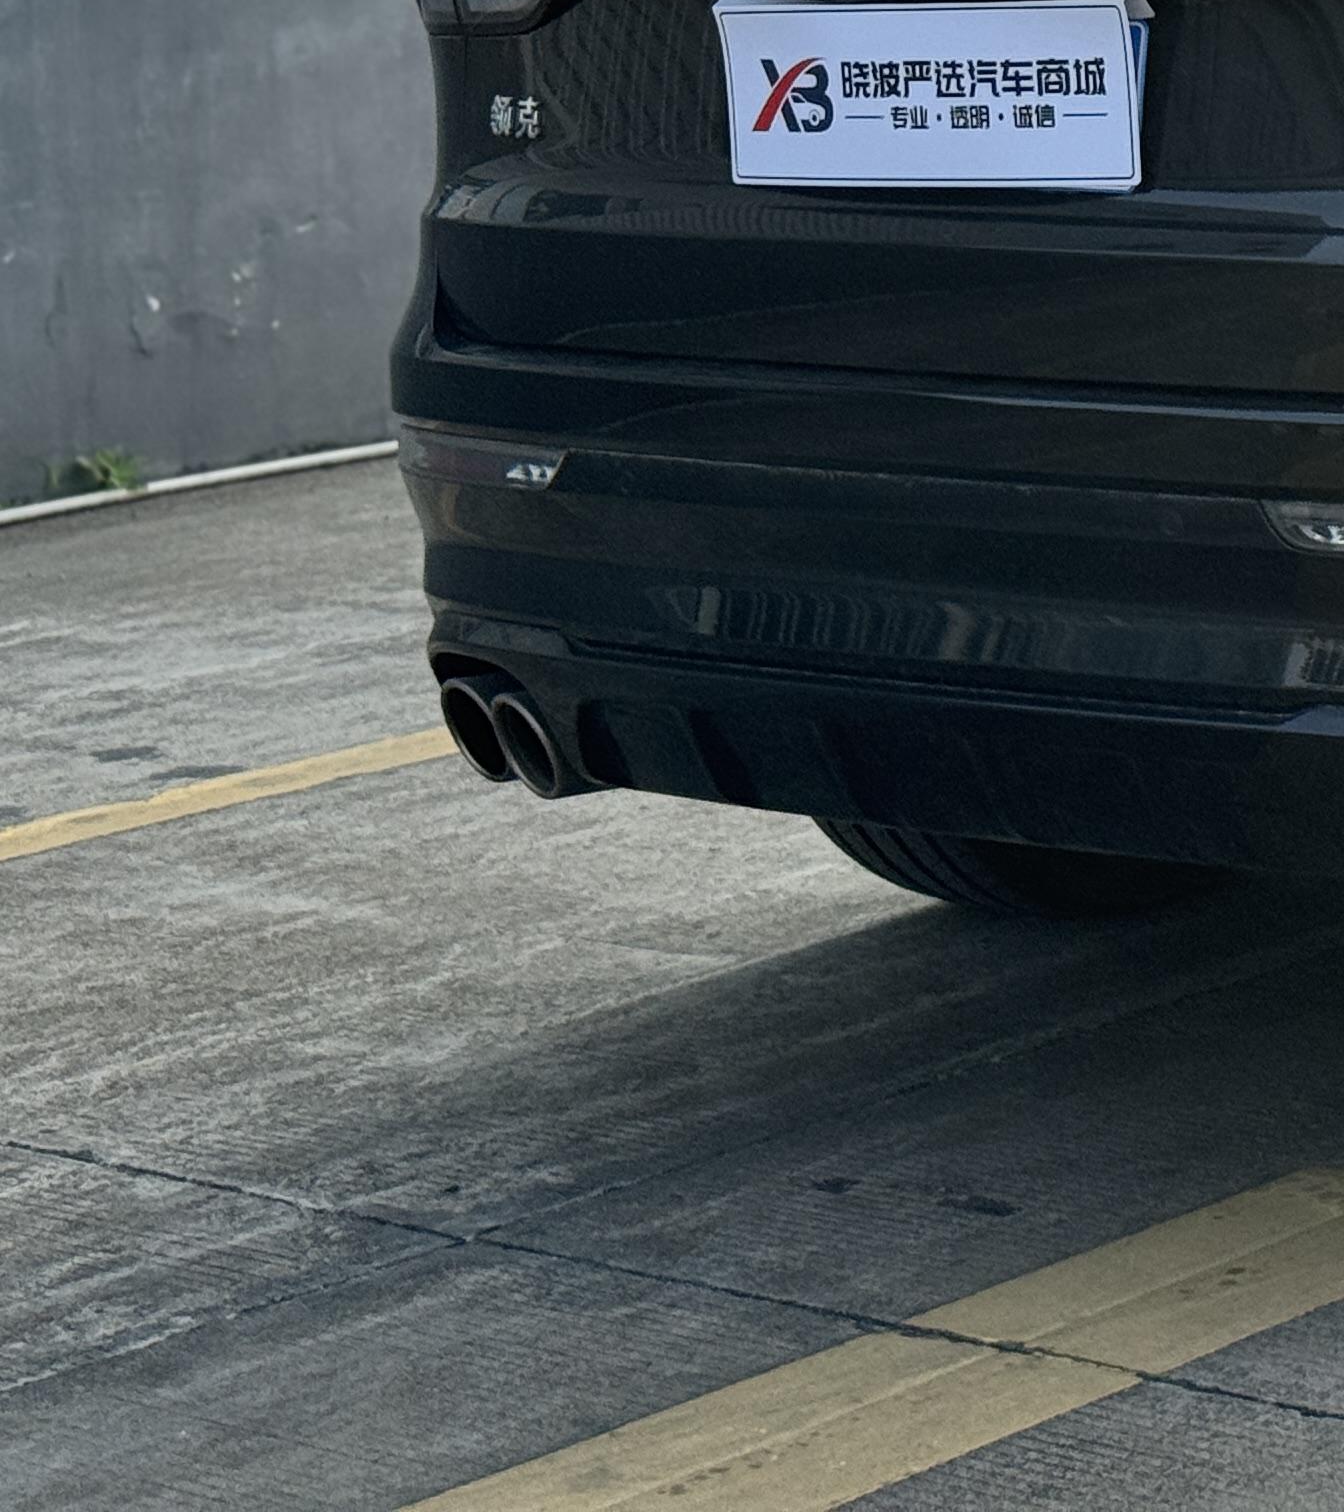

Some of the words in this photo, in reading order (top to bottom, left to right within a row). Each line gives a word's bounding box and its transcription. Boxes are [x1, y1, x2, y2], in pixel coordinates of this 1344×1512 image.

[840, 57, 1109, 98] 晓波严选汽车商城
